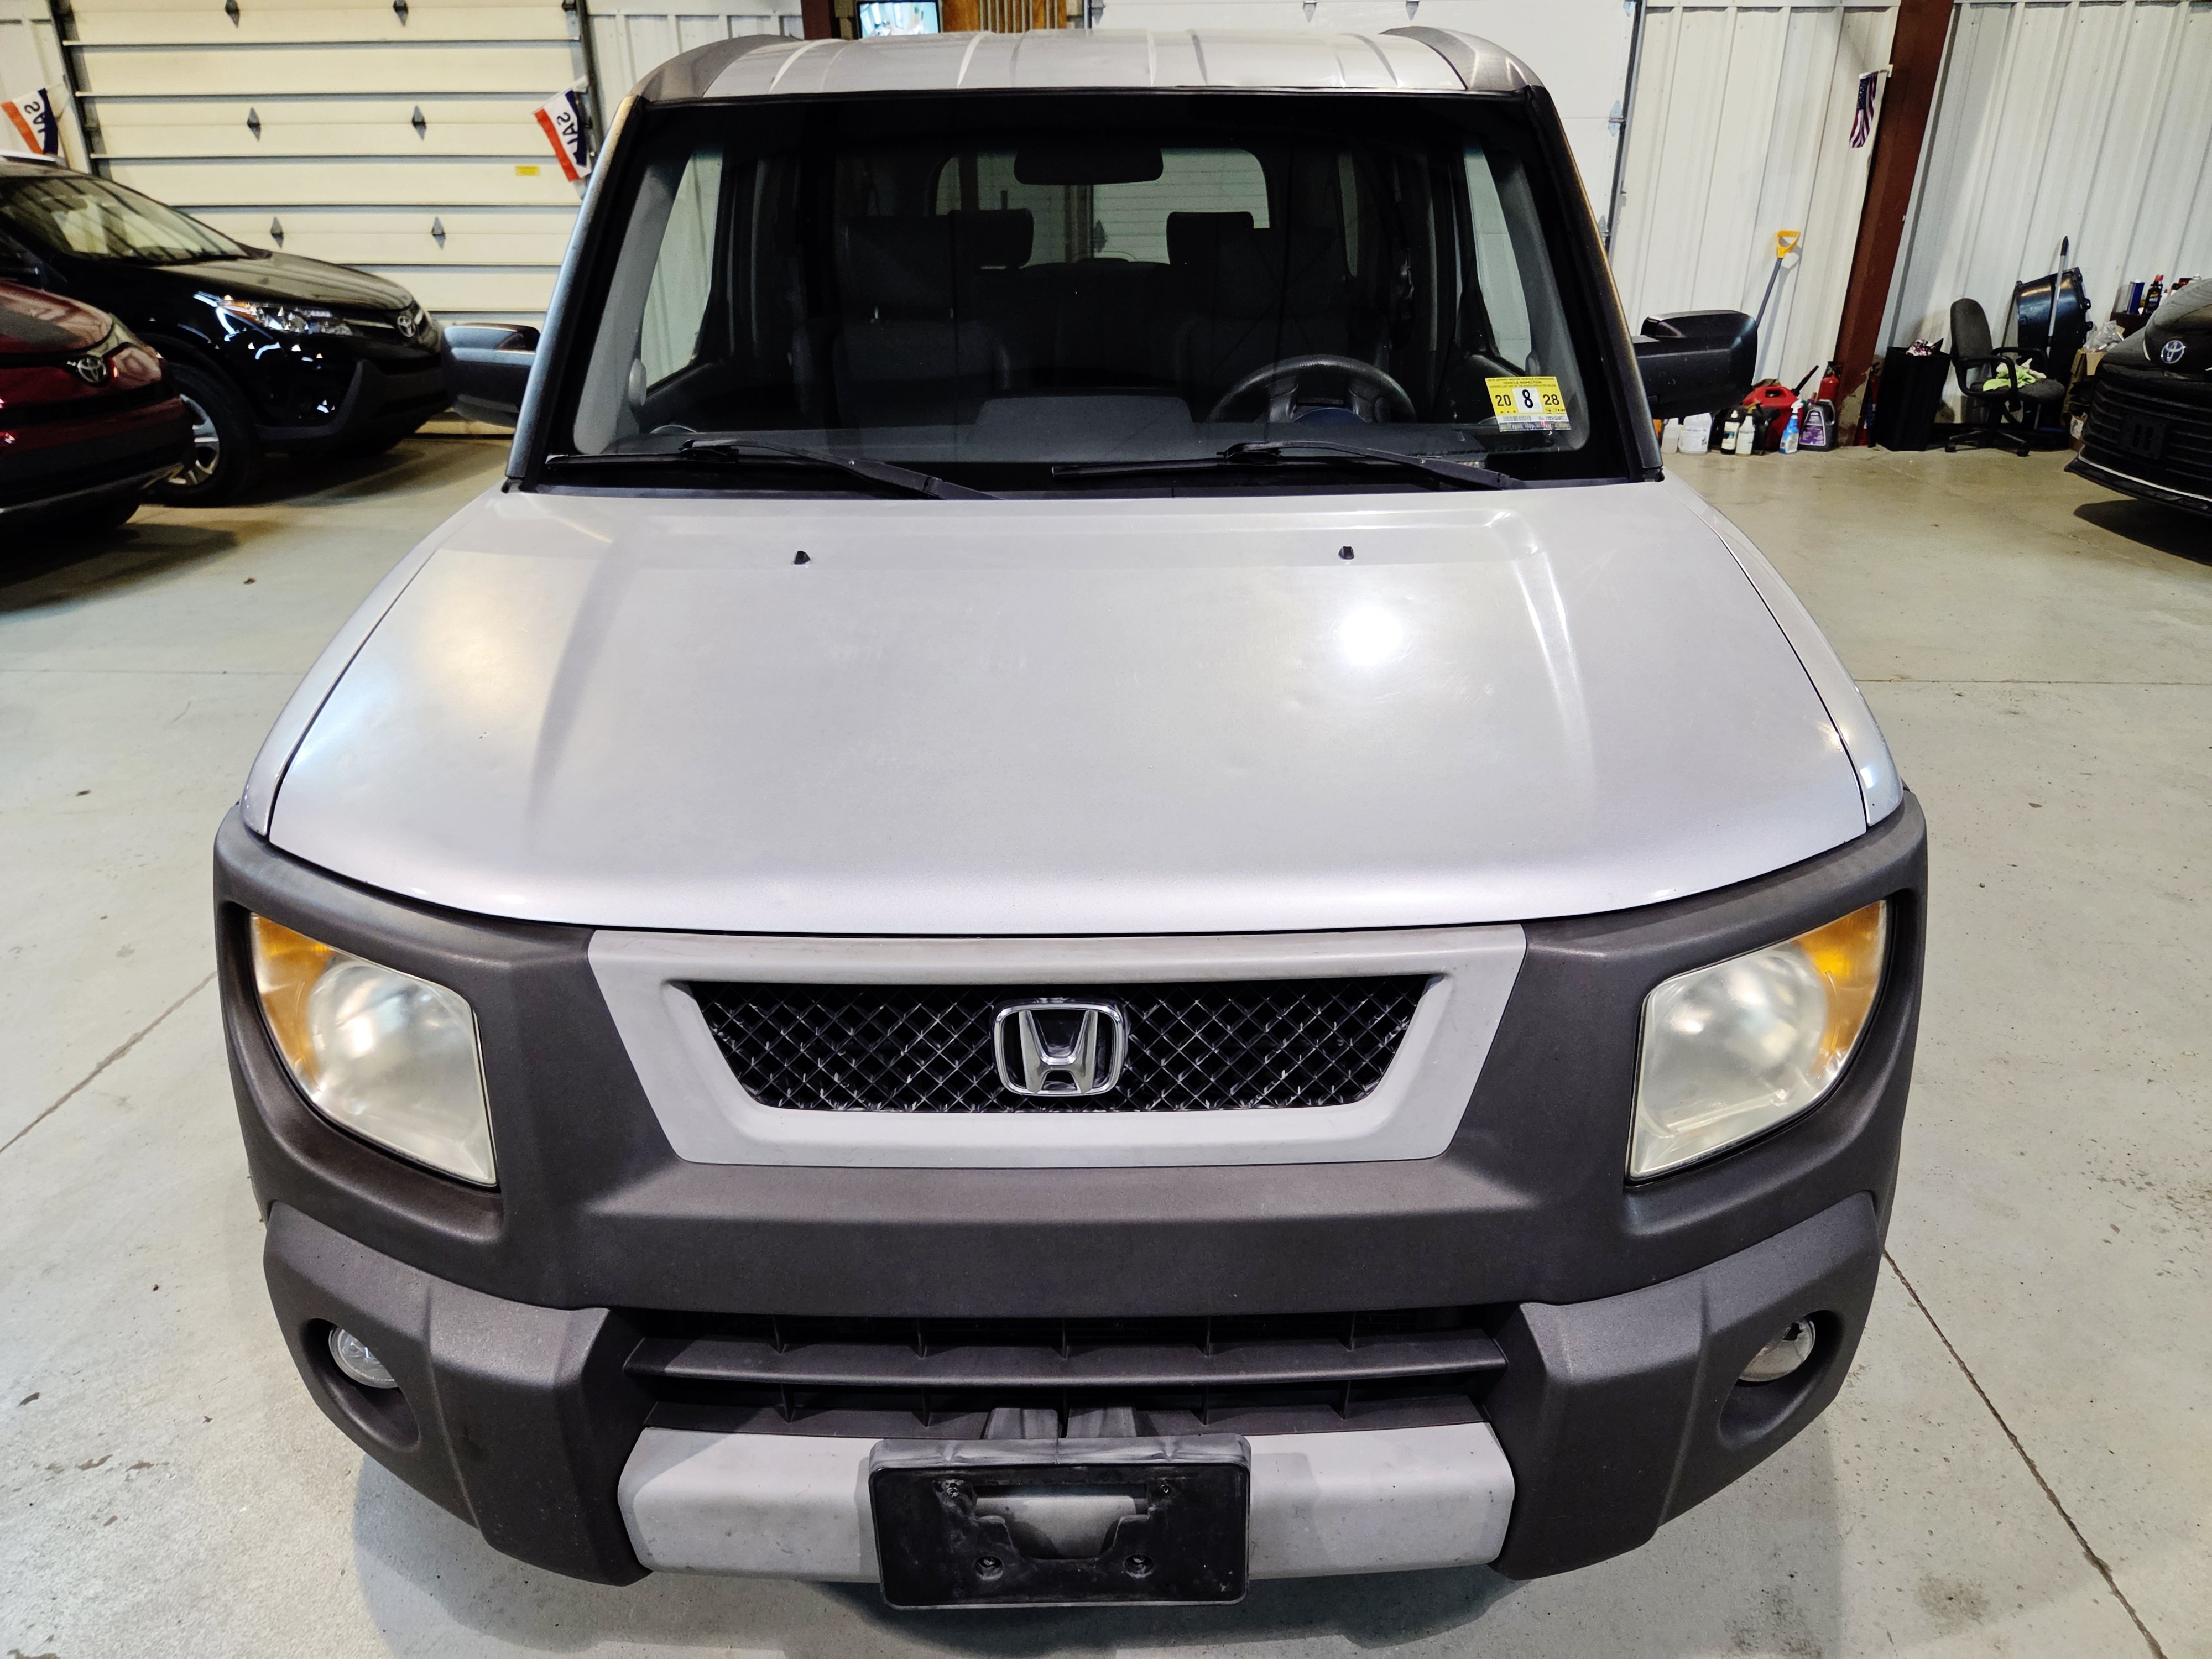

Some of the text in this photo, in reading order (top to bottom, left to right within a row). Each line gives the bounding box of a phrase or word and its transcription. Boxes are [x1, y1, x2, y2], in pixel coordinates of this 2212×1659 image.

[1495, 389, 1559, 408] 20 8 28
